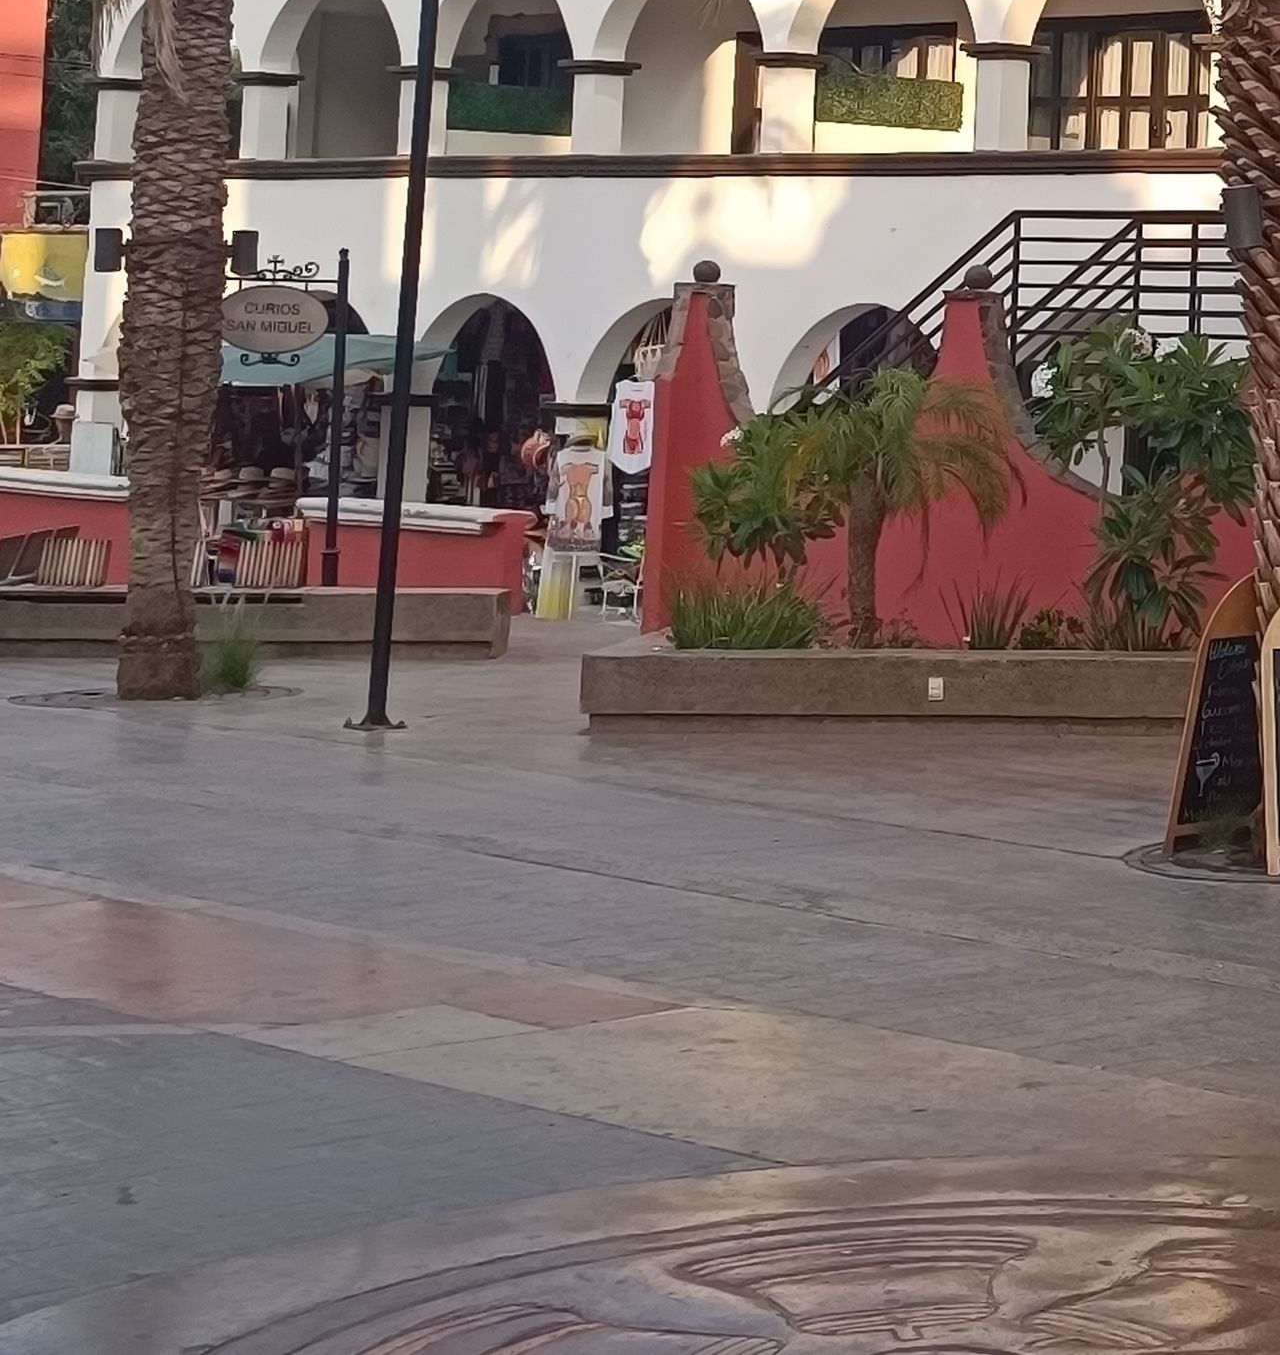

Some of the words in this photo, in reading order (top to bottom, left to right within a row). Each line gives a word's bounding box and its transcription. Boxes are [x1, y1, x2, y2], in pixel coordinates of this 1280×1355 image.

[244, 302, 301, 316] CURIOS
[225, 319, 256, 332] SAN
[260, 321, 316, 334] MIGUEL
